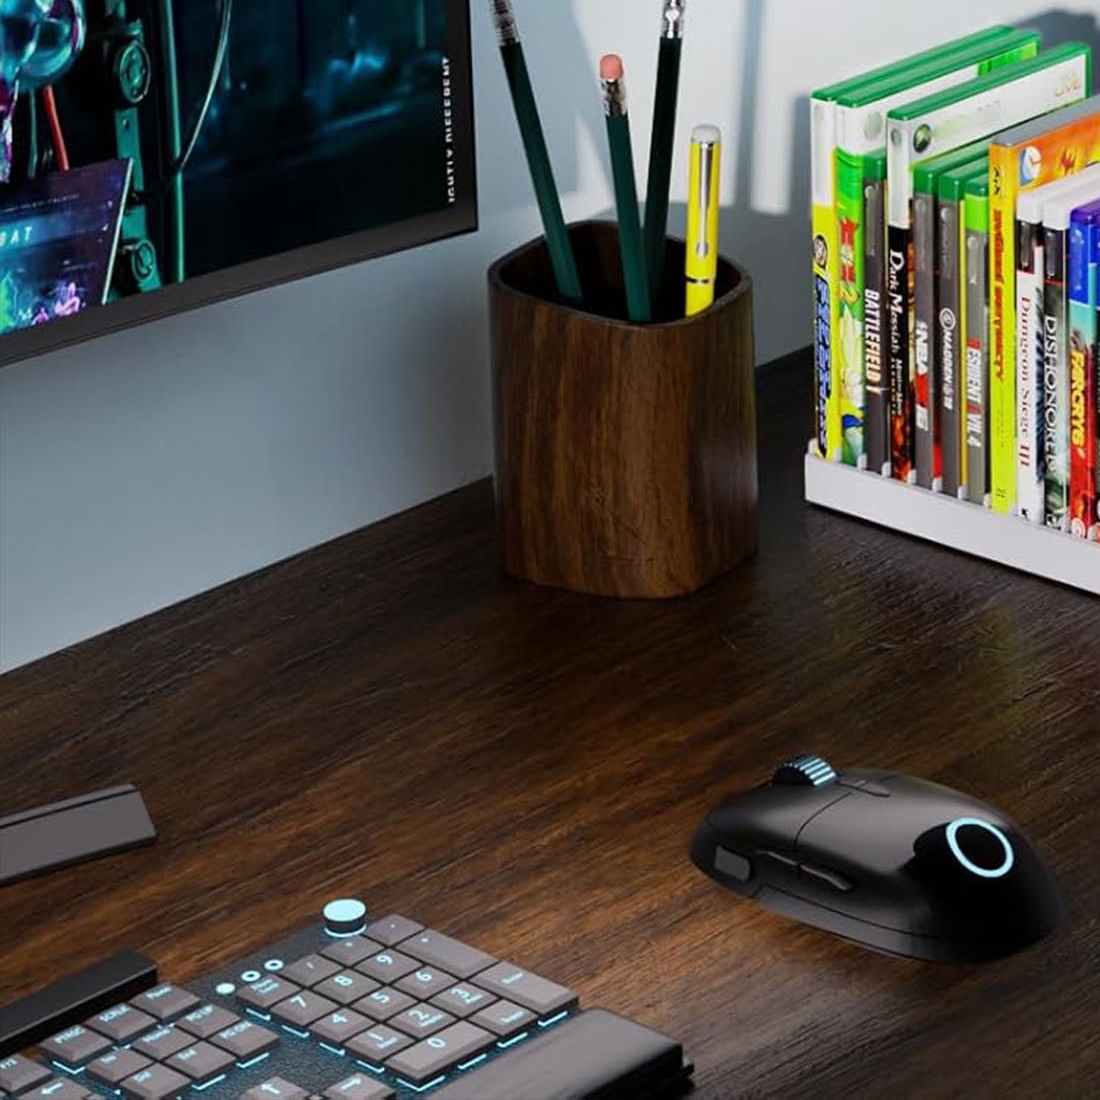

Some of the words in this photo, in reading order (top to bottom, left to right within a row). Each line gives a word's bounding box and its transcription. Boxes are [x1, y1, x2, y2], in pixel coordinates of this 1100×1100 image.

[888, 249, 904, 290] Dark
[887, 291, 903, 353] Messiah
[865, 289, 882, 381] BATTLEFIELD
[1019, 296, 1032, 381] Dungeon
[942, 329, 953, 382] MADDEN
[1019, 387, 1032, 438] Siege
[375, 954, 393, 966] 9
[334, 975, 352, 987] 8
[415, 970, 432, 983] 6
[371, 991, 390, 1004] 5
[450, 987, 471, 1001] 3
[290, 995, 306, 1008] 7
[332, 1013, 348, 1025] 4
[408, 1009, 428, 1022] 2
[366, 1032, 383, 1042] 1
[427, 1037, 447, 1049] 0
